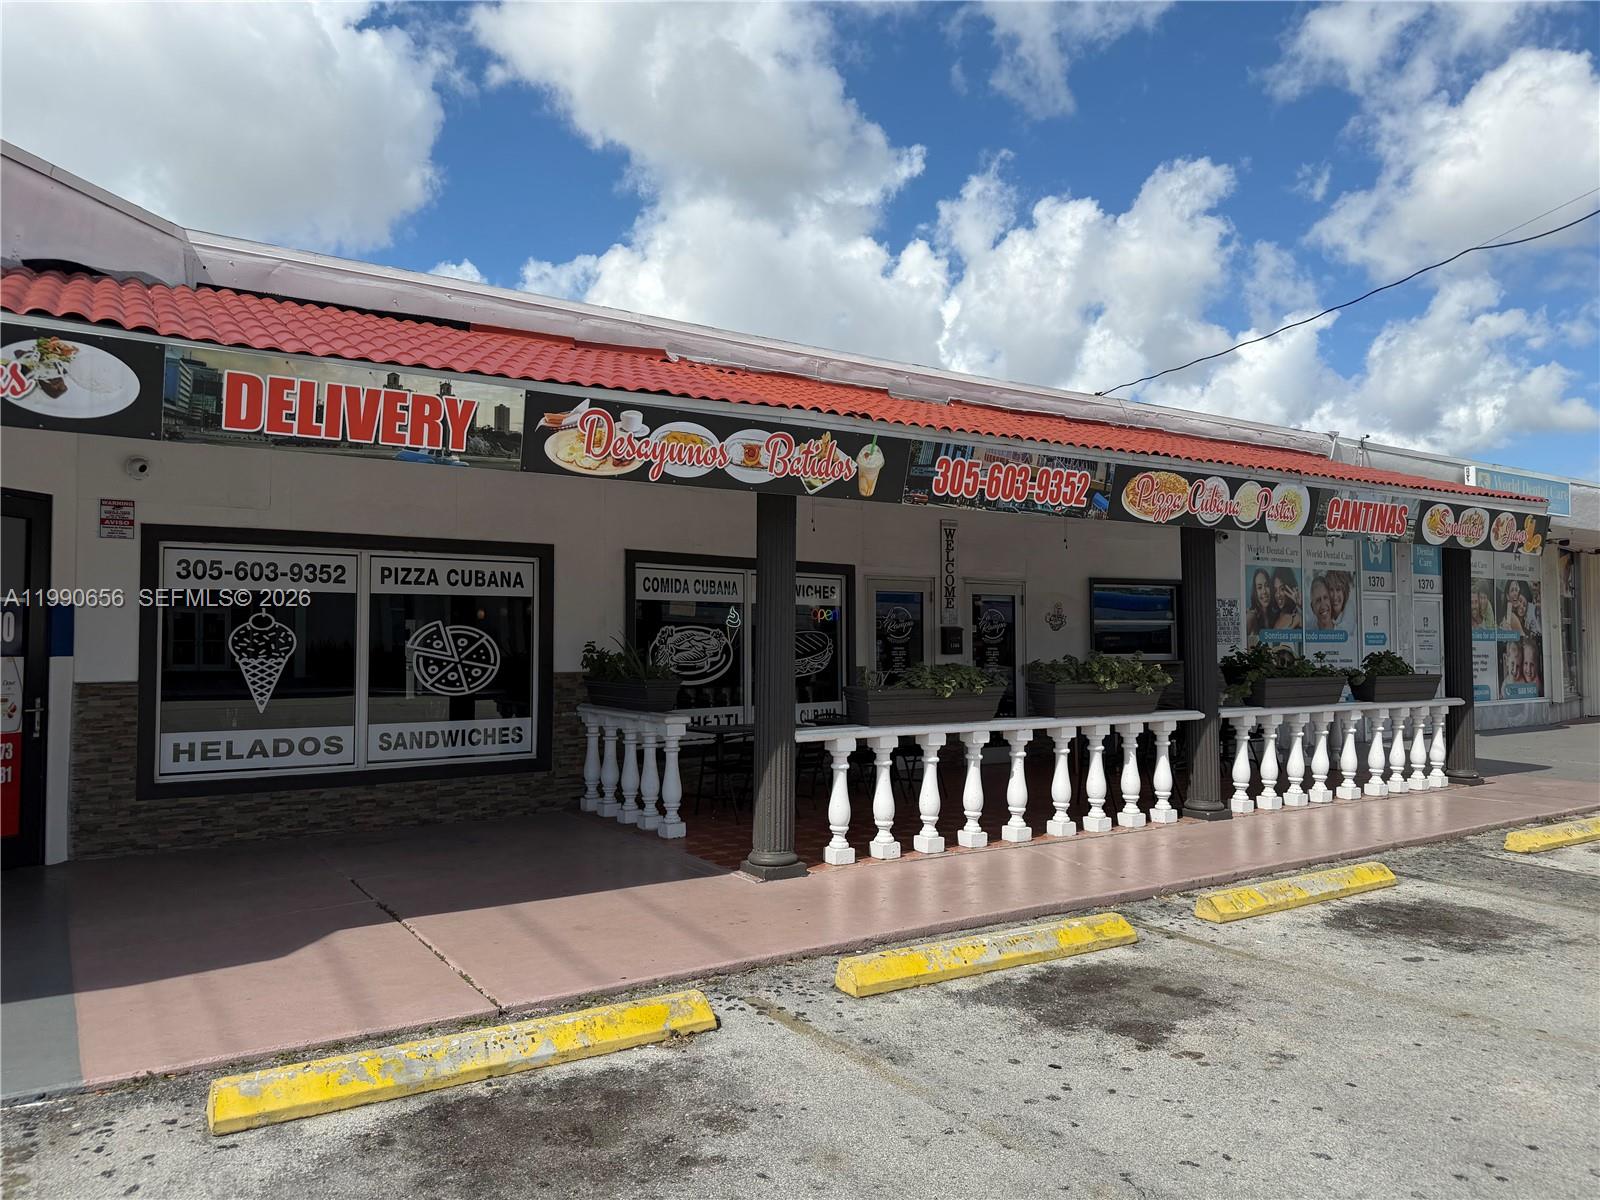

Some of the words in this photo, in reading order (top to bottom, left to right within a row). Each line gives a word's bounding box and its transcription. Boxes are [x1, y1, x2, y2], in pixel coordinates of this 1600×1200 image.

[222, 370, 478, 453] DELIVERY
[578, 407, 730, 481] Desayunos
[765, 432, 858, 481] Batidos
[932, 455, 1091, 507] 305-603-9352
[1135, 471, 1183, 523] Pizza
[1187, 478, 1241, 517] Cubana
[1255, 486, 1298, 524] Pastas
[1325, 496, 1409, 537] CANTINAS
[1247, 543, 1265, 554] World
[1266, 546, 1284, 556] Dental
[1286, 546, 1299, 557] Care
[1306, 549, 1322, 559] World
[1323, 550, 1341, 560] Dental
[175, 557, 347, 585] 305-603-9352
[379, 565, 440, 588] PIZZA
[446, 567, 525, 589] CUBANA
[943, 528, 957, 609] WELCOME
[1367, 576, 1385, 588] 1370
[643, 576, 690, 594] COMIDA
[693, 579, 738, 596] CUBANA
[1418, 578, 1435, 590] 1370
[811, 607, 840, 623] open
[1263, 630, 1289, 640] Sonrisas
[1290, 632, 1303, 641] para
[1305, 631, 1319, 640] todo
[171, 736, 344, 763] HELADOS
[378, 725, 524, 752] SANDWICHES
